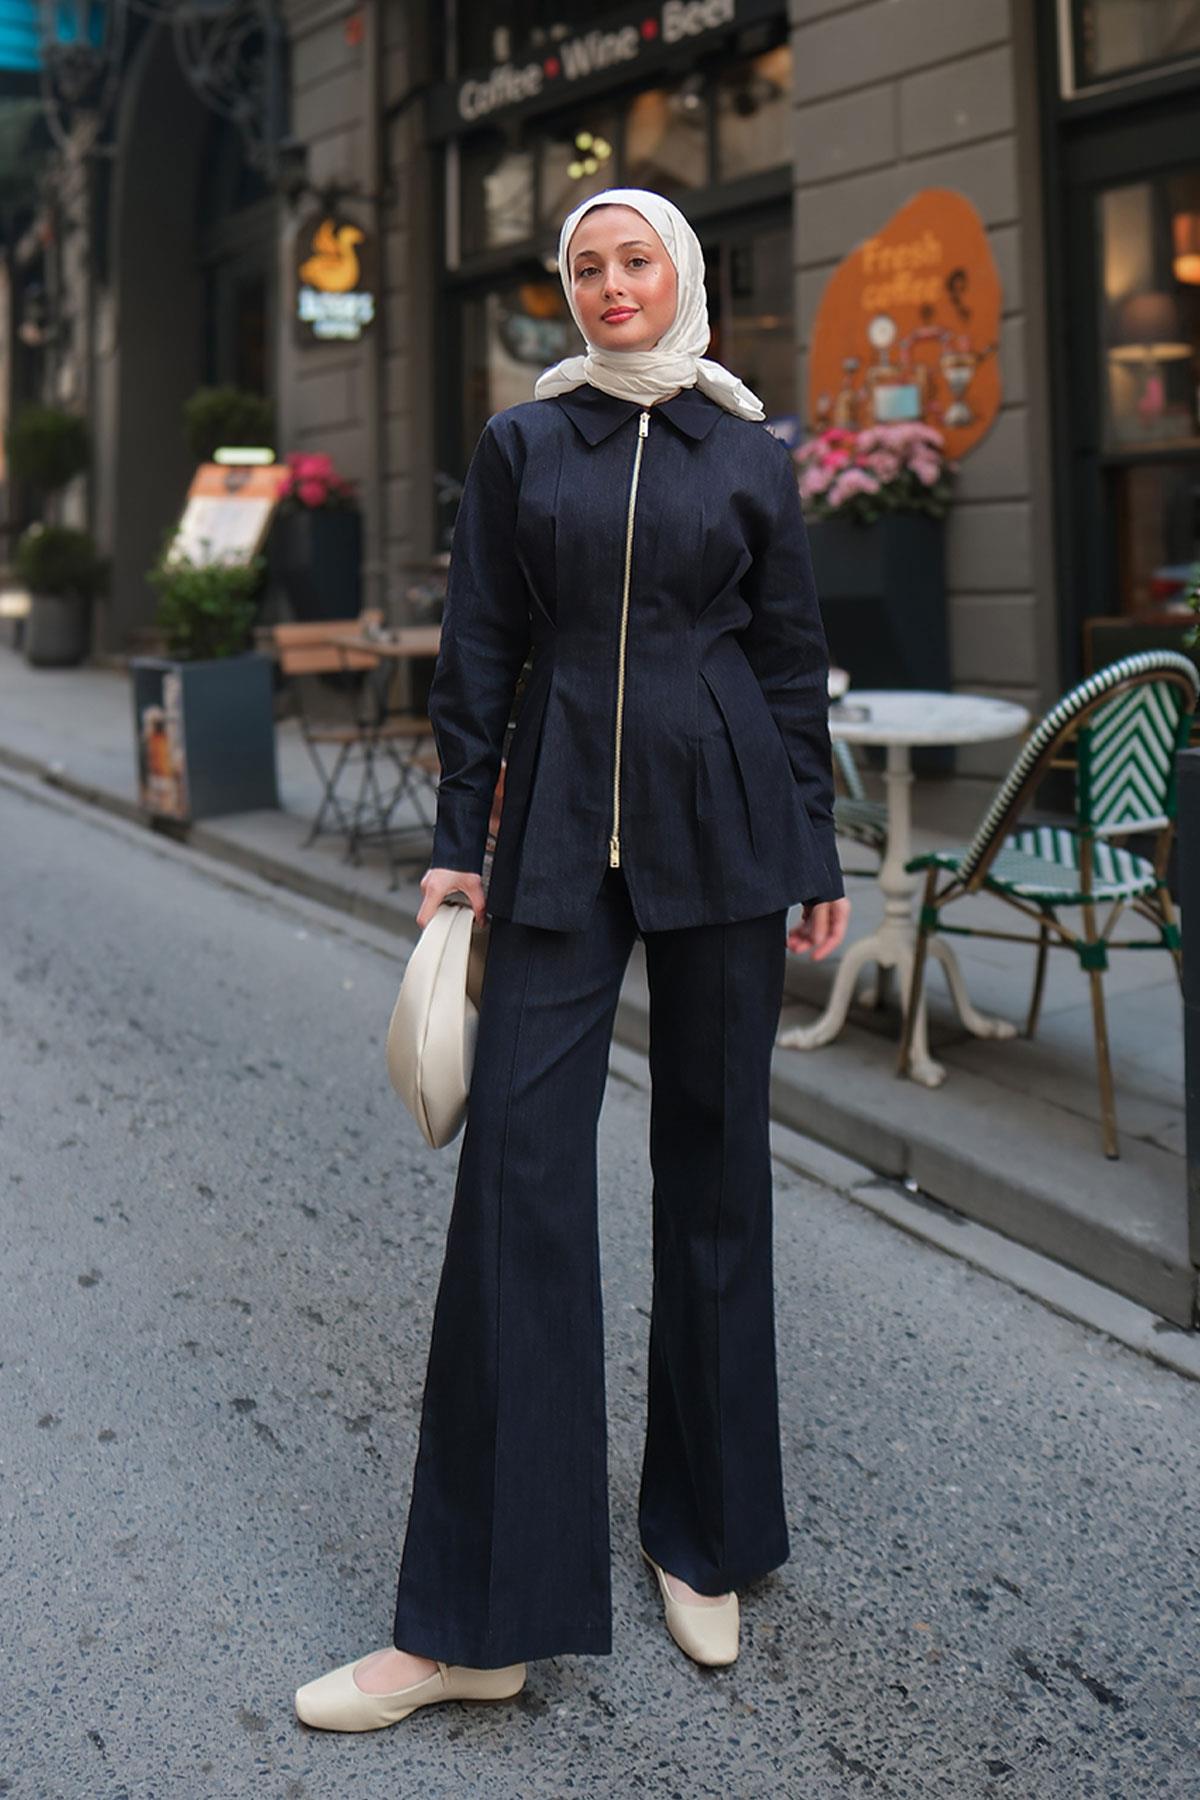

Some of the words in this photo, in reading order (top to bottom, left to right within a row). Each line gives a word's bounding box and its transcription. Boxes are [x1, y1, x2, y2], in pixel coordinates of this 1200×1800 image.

[459, 62, 543, 121] Coffee
[559, 27, 640, 81] Wine
[861, 232, 942, 272] Fresh
[861, 269, 942, 310] coffee
